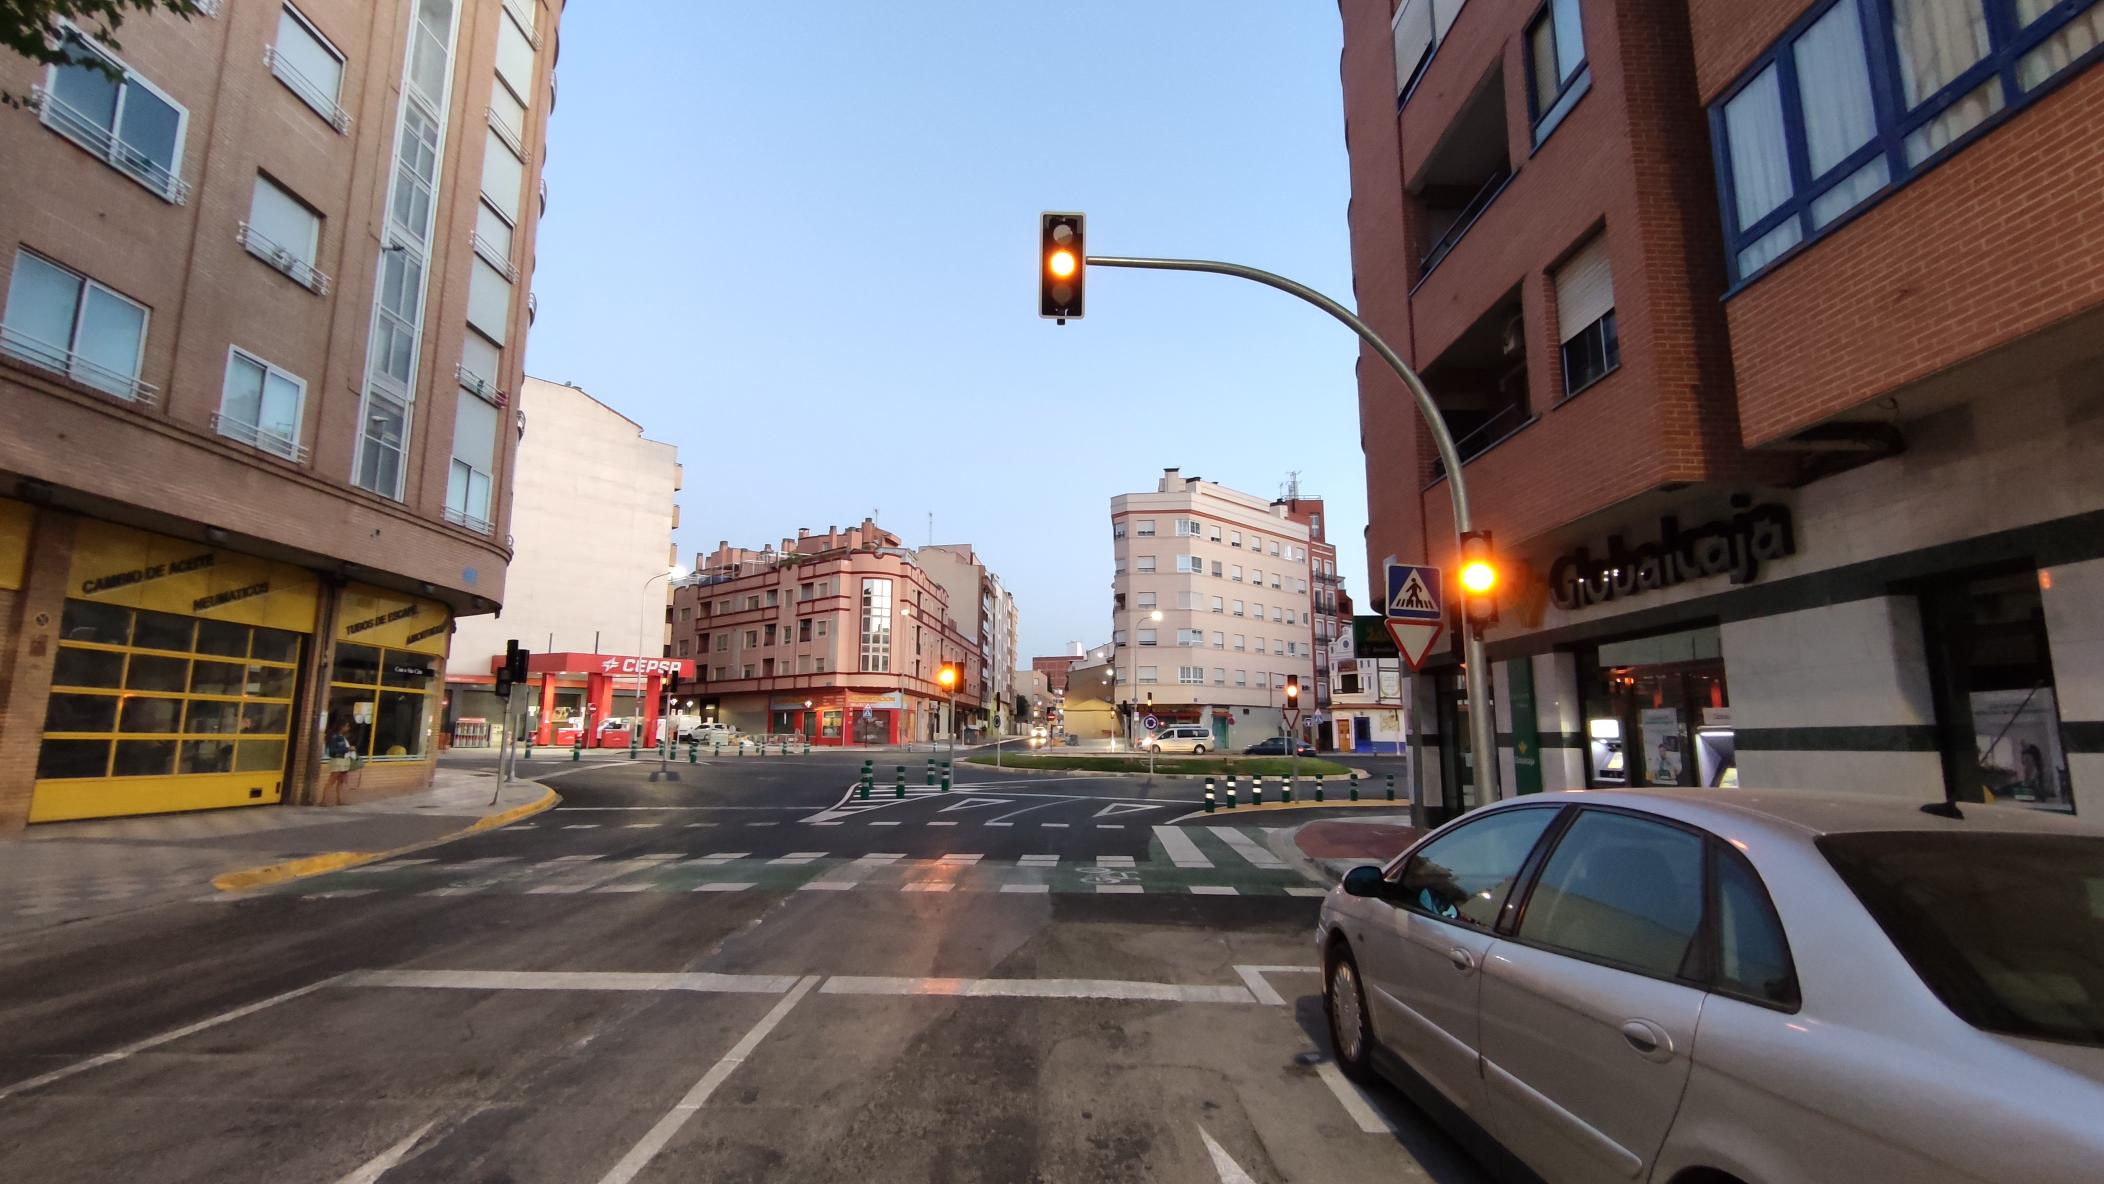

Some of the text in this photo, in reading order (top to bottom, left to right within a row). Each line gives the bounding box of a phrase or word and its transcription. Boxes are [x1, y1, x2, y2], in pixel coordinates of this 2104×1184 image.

[1550, 493, 1796, 610] Globalcaja
[82, 553, 215, 595] CAMBIO DE ACEITE
[346, 618, 374, 636] TUBOS
[375, 614, 387, 627] DE
[622, 658, 682, 675] CEPSA
